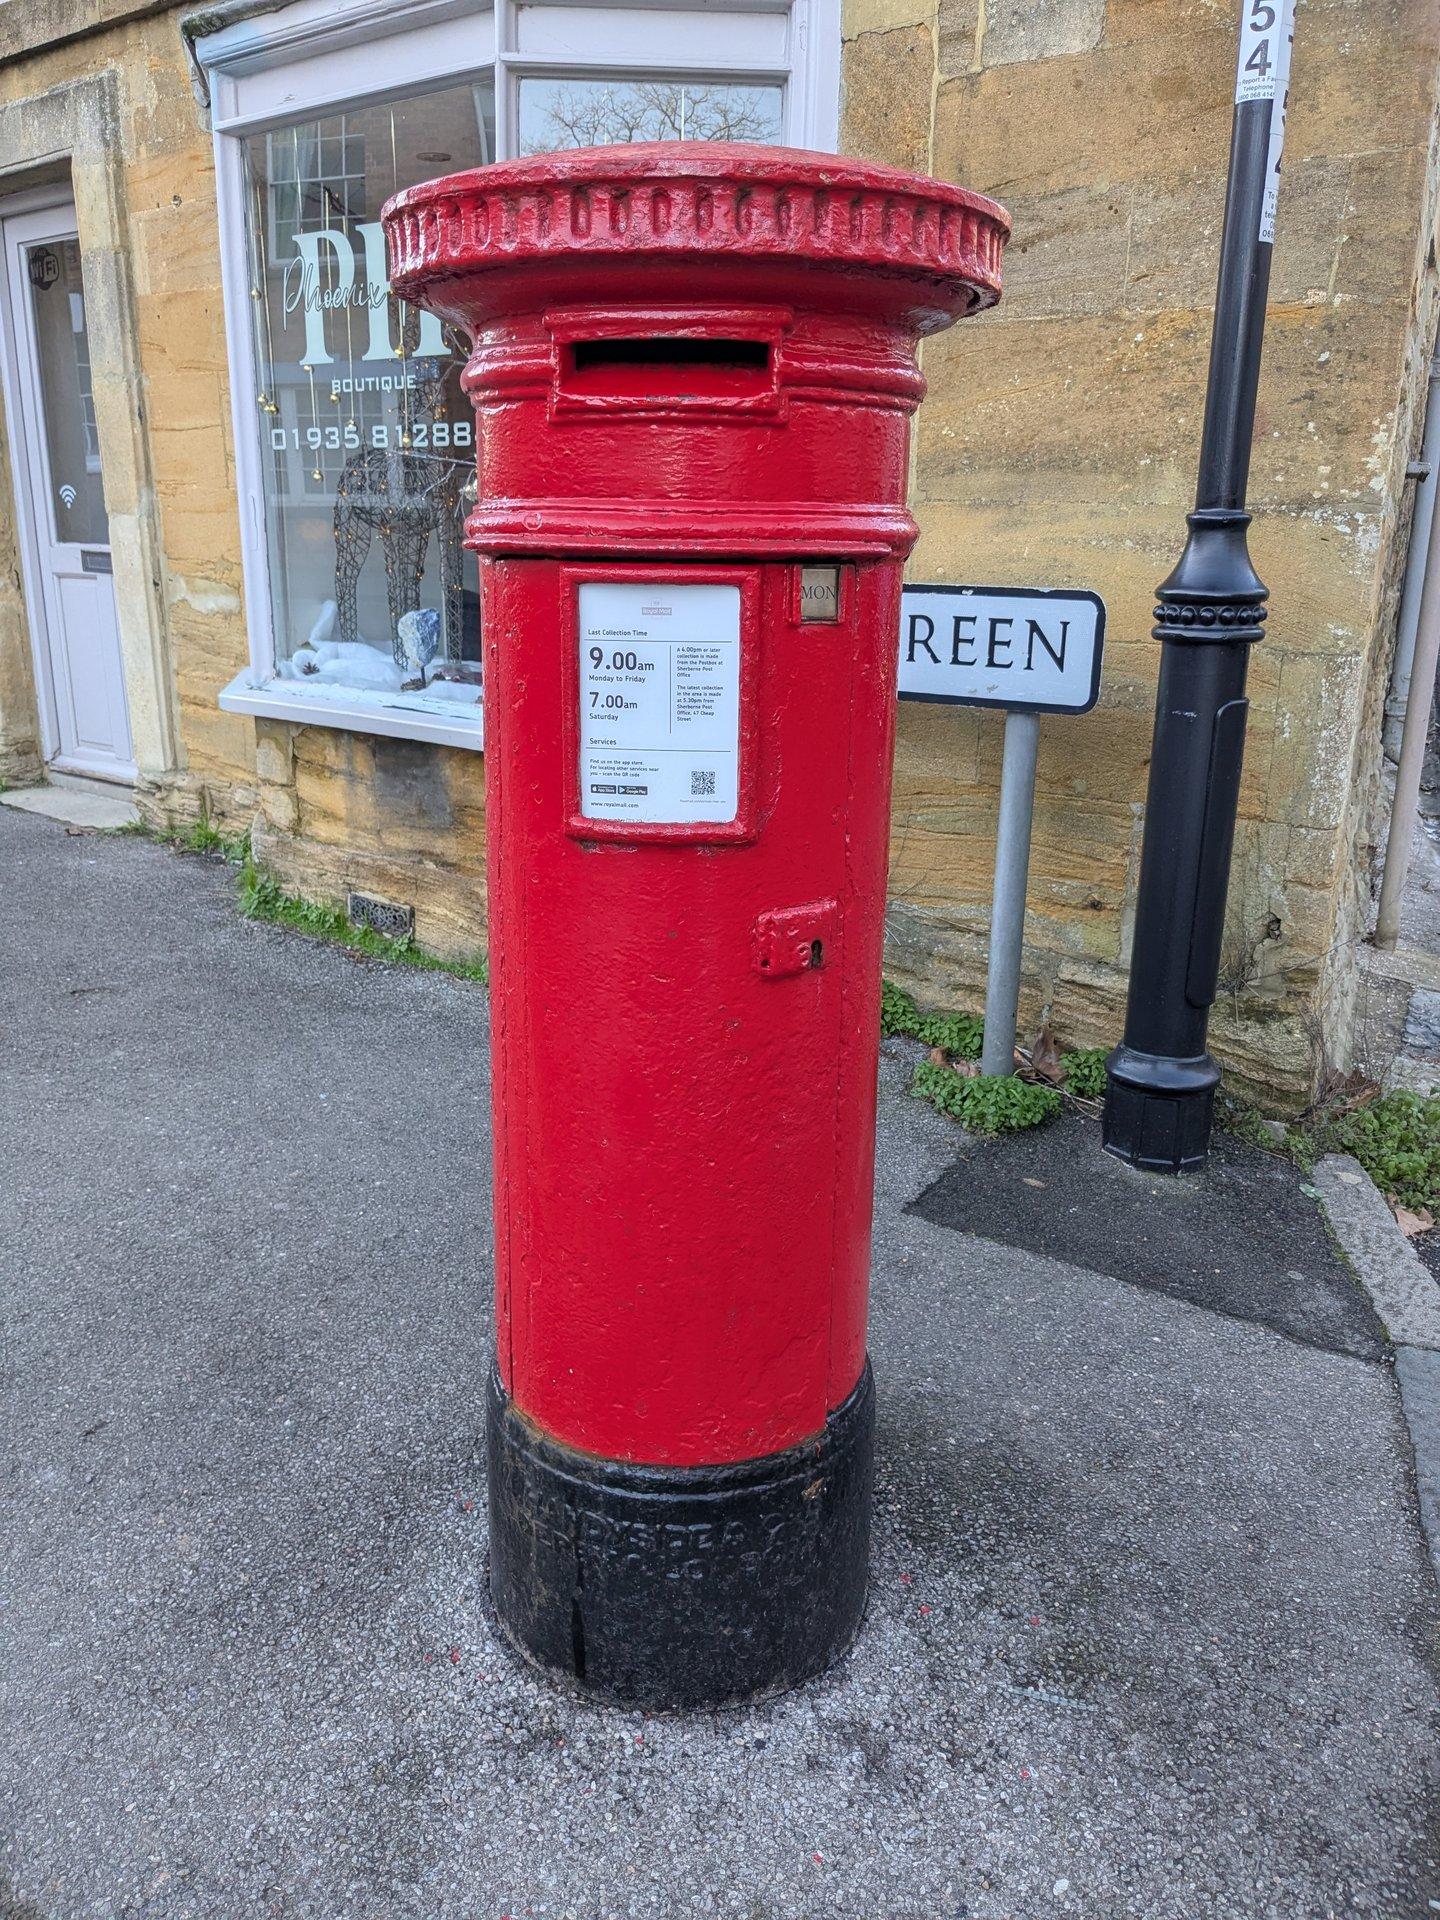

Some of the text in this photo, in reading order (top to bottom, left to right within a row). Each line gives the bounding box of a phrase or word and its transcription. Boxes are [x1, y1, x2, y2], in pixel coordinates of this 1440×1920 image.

[1249, 0, 1276, 32] 5
[1244, 38, 1272, 76] 4
[1242, 77, 1260, 86] Report
[283, 255, 386, 332] Phoenix
[331, 374, 416, 393] BOUTIQUE
[271, 426, 360, 450] 01935
[800, 586, 836, 600] MON
[906, 614, 1071, 674] REEN
[590, 646, 654, 670] 9.00am
[590, 692, 638, 709] 7.00am
[590, 713, 618, 722] Saturday
